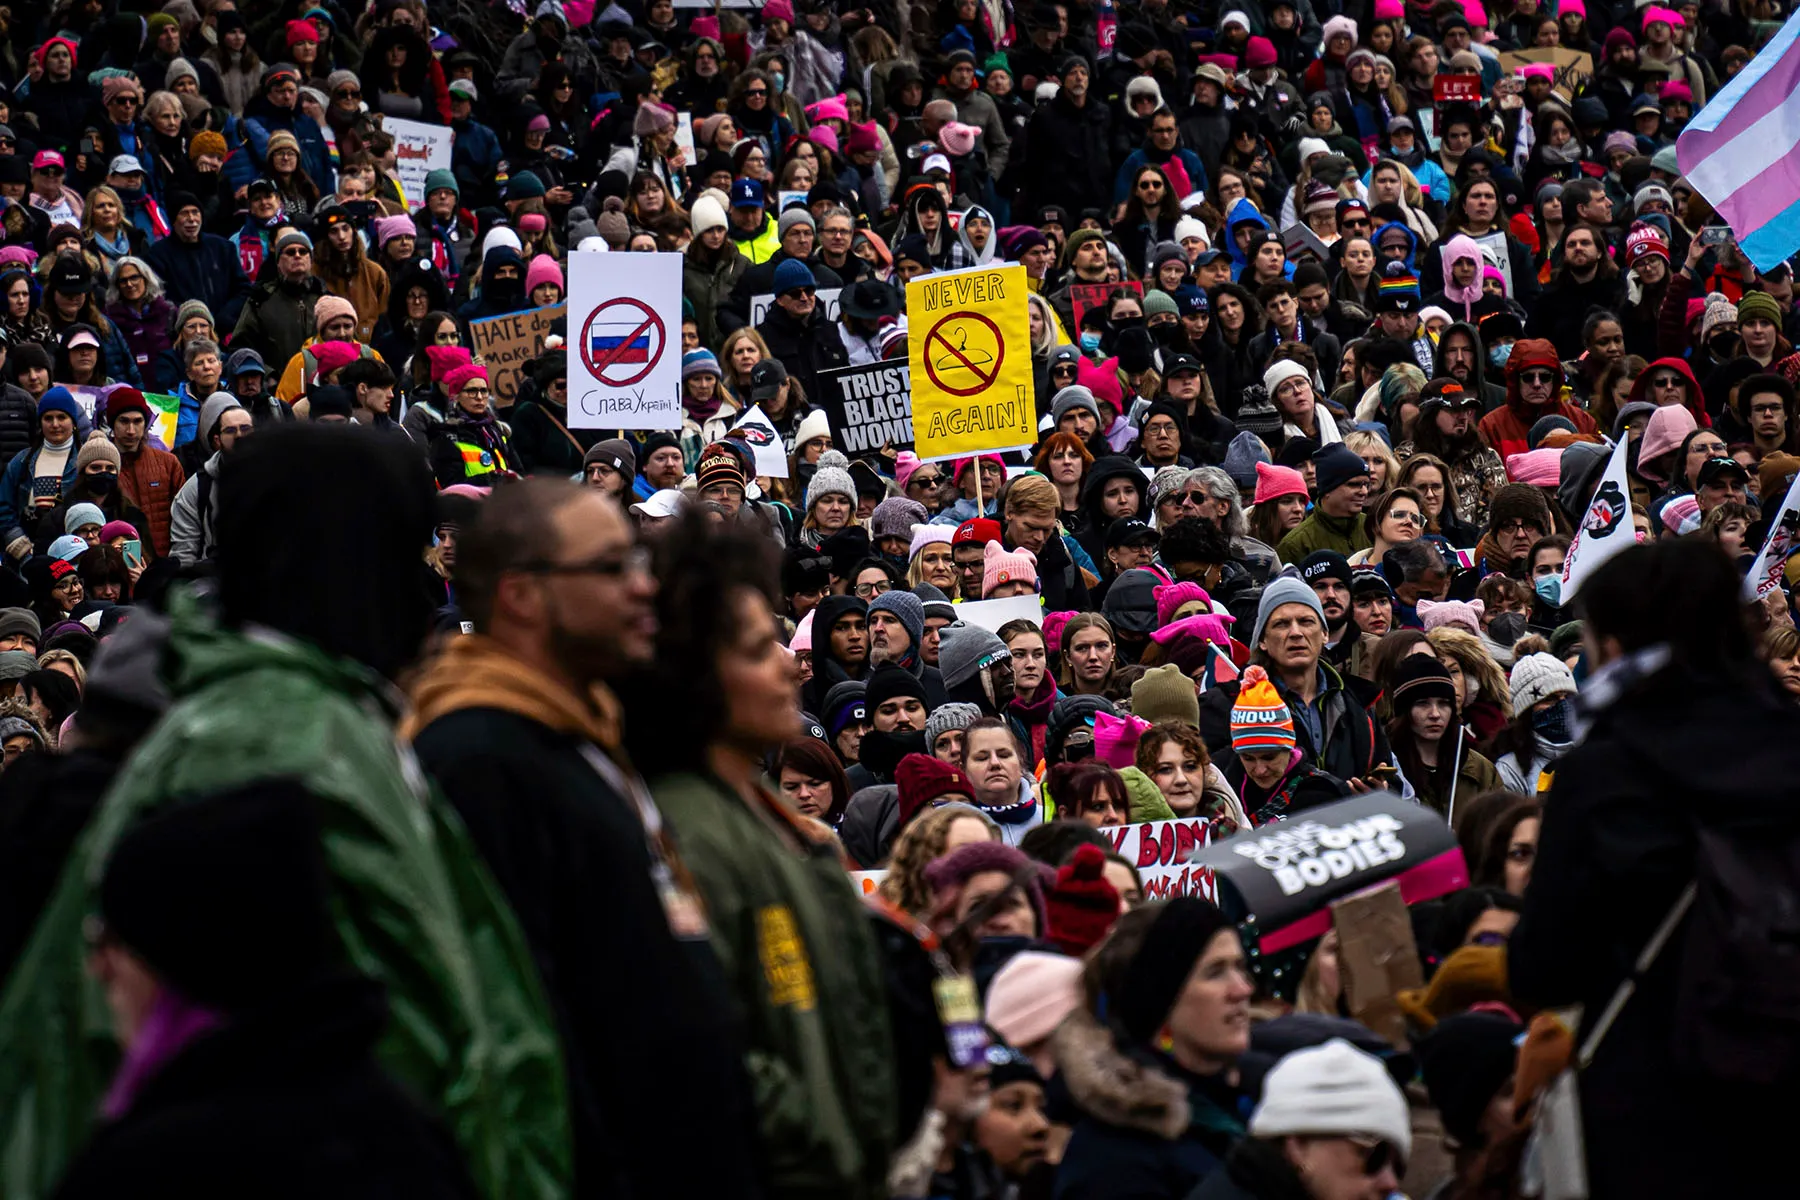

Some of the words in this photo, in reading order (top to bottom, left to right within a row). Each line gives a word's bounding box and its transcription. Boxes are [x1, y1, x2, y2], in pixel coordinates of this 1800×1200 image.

[1443, 82, 1472, 93] LET
[924, 273, 1005, 311] NEVER
[472, 316, 526, 350] HATE
[837, 366, 911, 401] TRUST
[580, 389, 633, 416] Слава
[928, 384, 1028, 438] AGAIN!
[840, 417, 915, 453] WOME
[1313, 566, 1326, 575] CLUB
[1231, 709, 1277, 723] SHOW
[1136, 821, 1210, 867] BODY
[1272, 831, 1407, 896] BODIES
